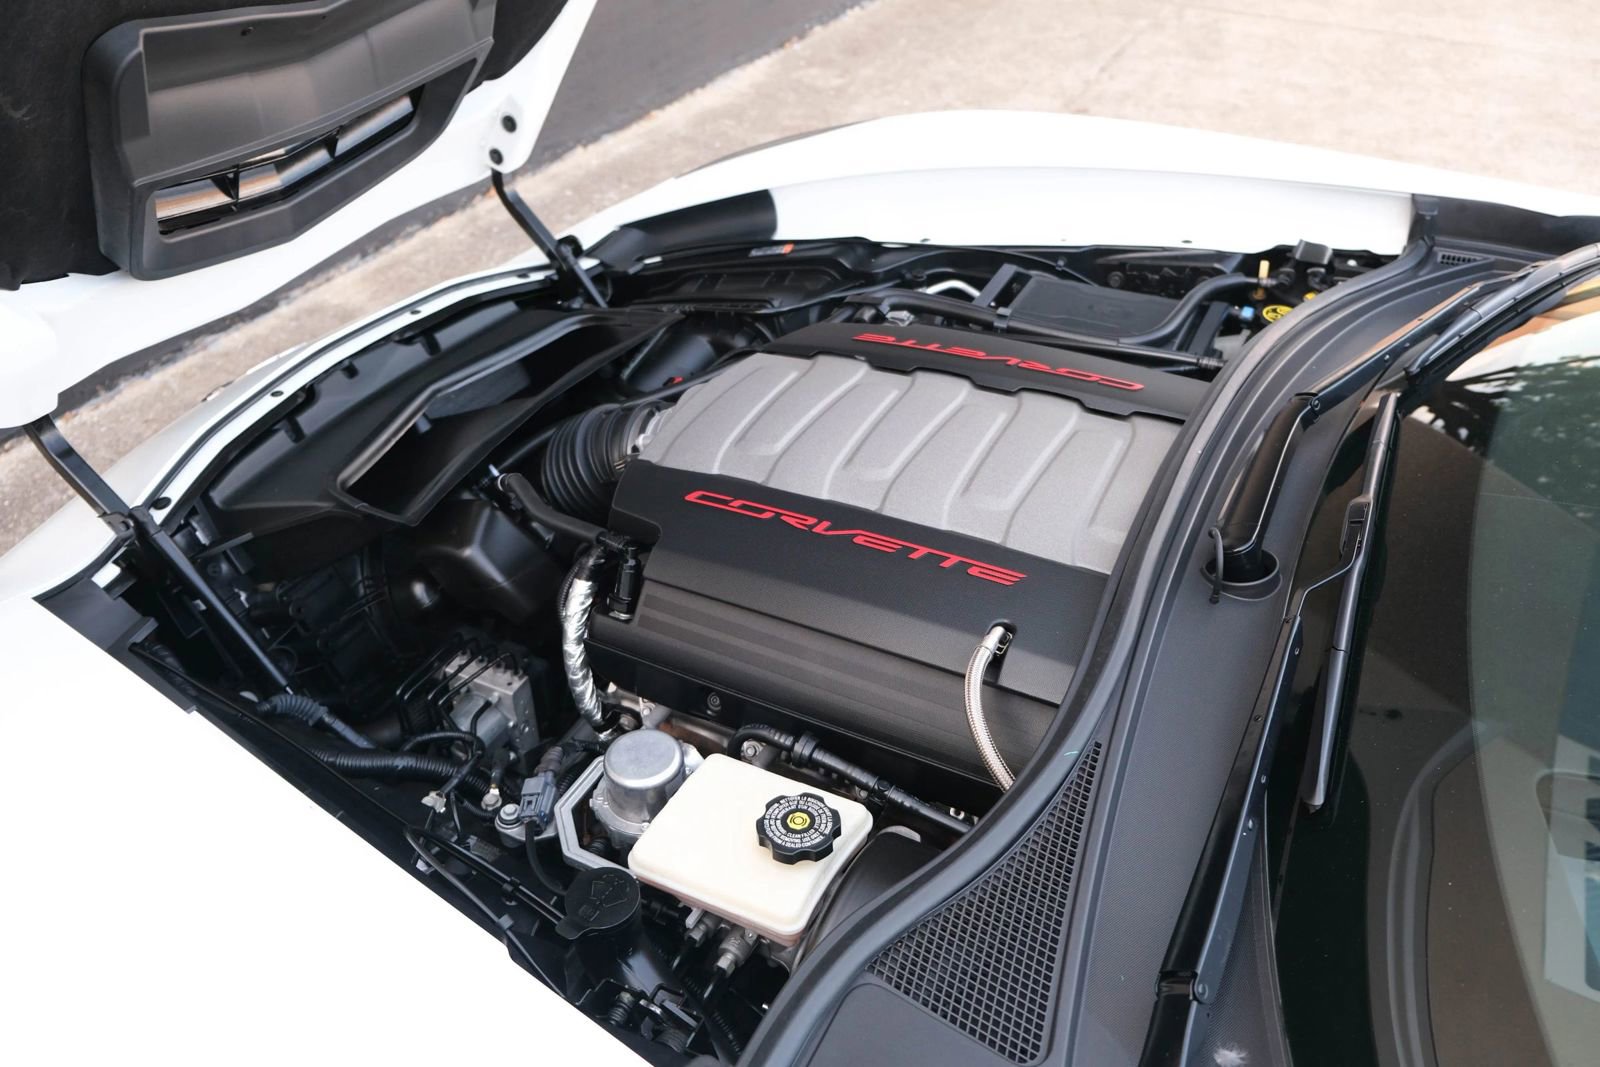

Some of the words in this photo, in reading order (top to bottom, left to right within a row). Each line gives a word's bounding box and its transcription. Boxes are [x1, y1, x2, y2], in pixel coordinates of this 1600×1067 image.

[852, 332, 1145, 391] CORVETTE
[683, 490, 1028, 586] CORVETTE
[802, 829, 815, 838] FILLER
